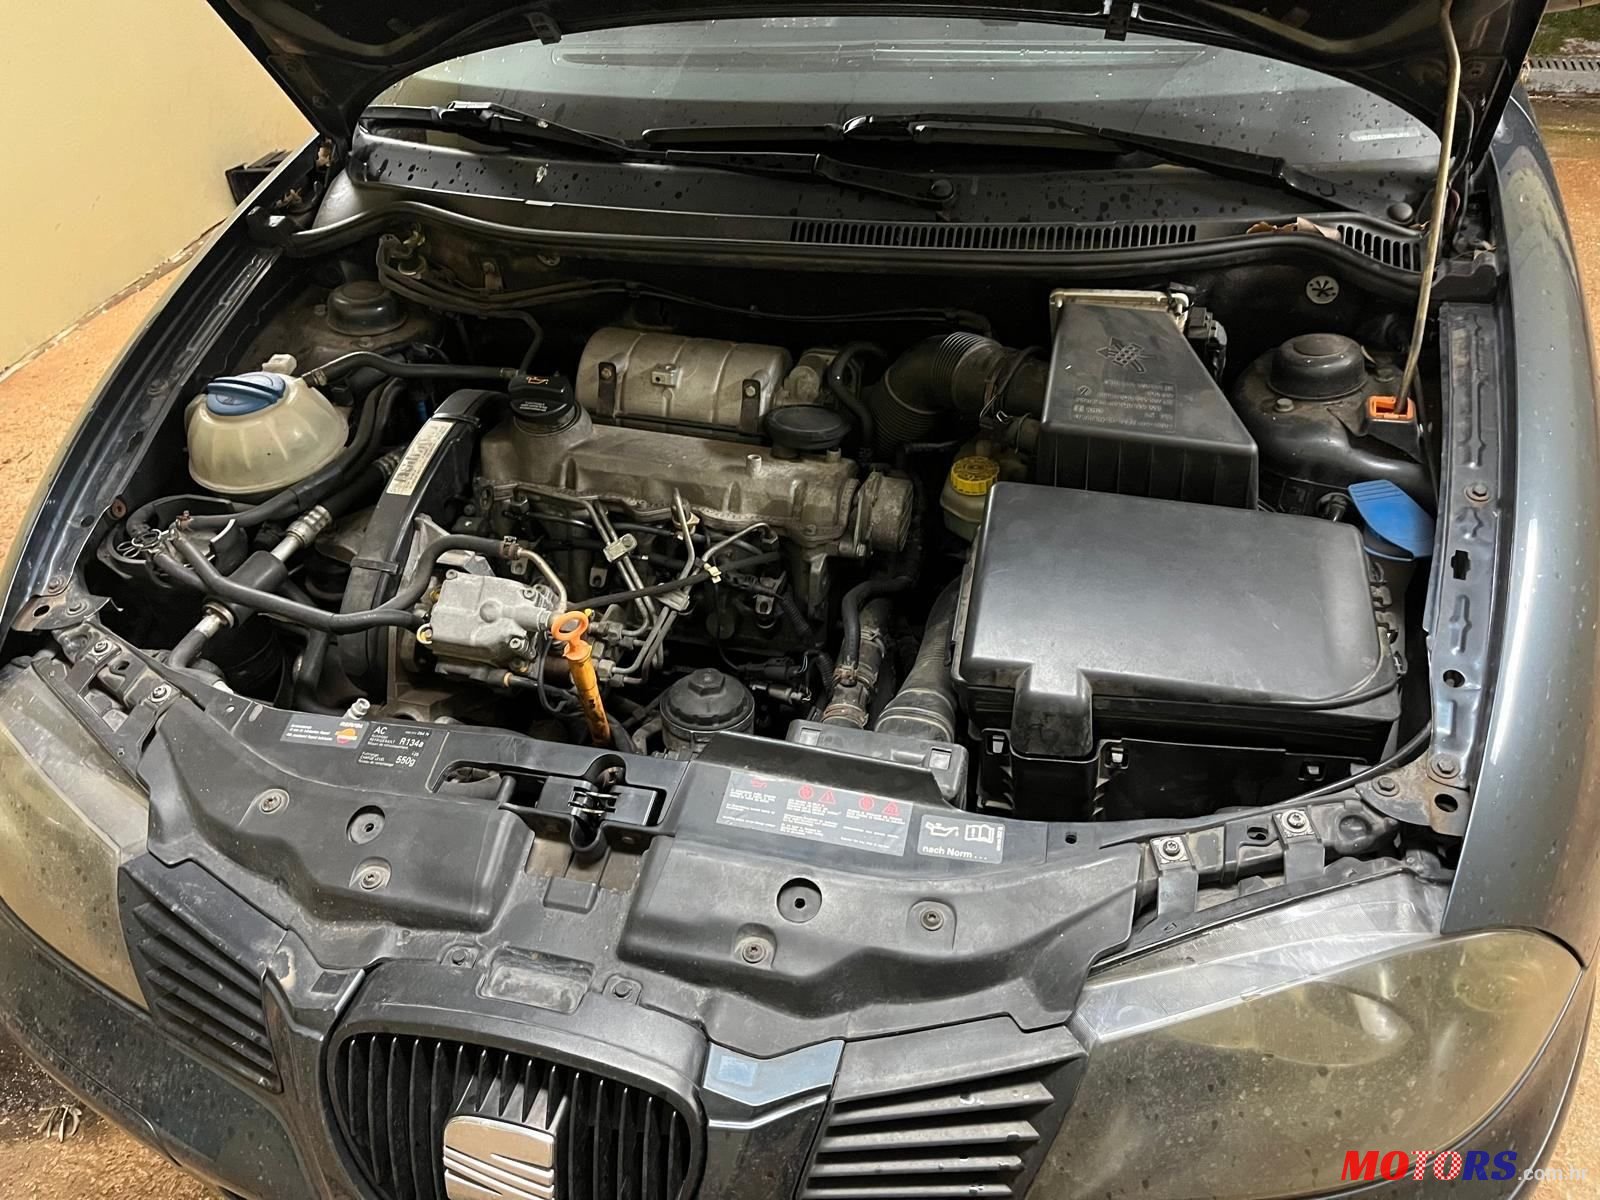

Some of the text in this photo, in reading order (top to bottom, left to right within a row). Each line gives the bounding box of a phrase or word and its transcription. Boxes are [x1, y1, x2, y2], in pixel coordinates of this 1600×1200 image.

[373, 725, 388, 735] AC
[395, 755, 416, 768] 550g
[922, 845, 945, 855] nach
